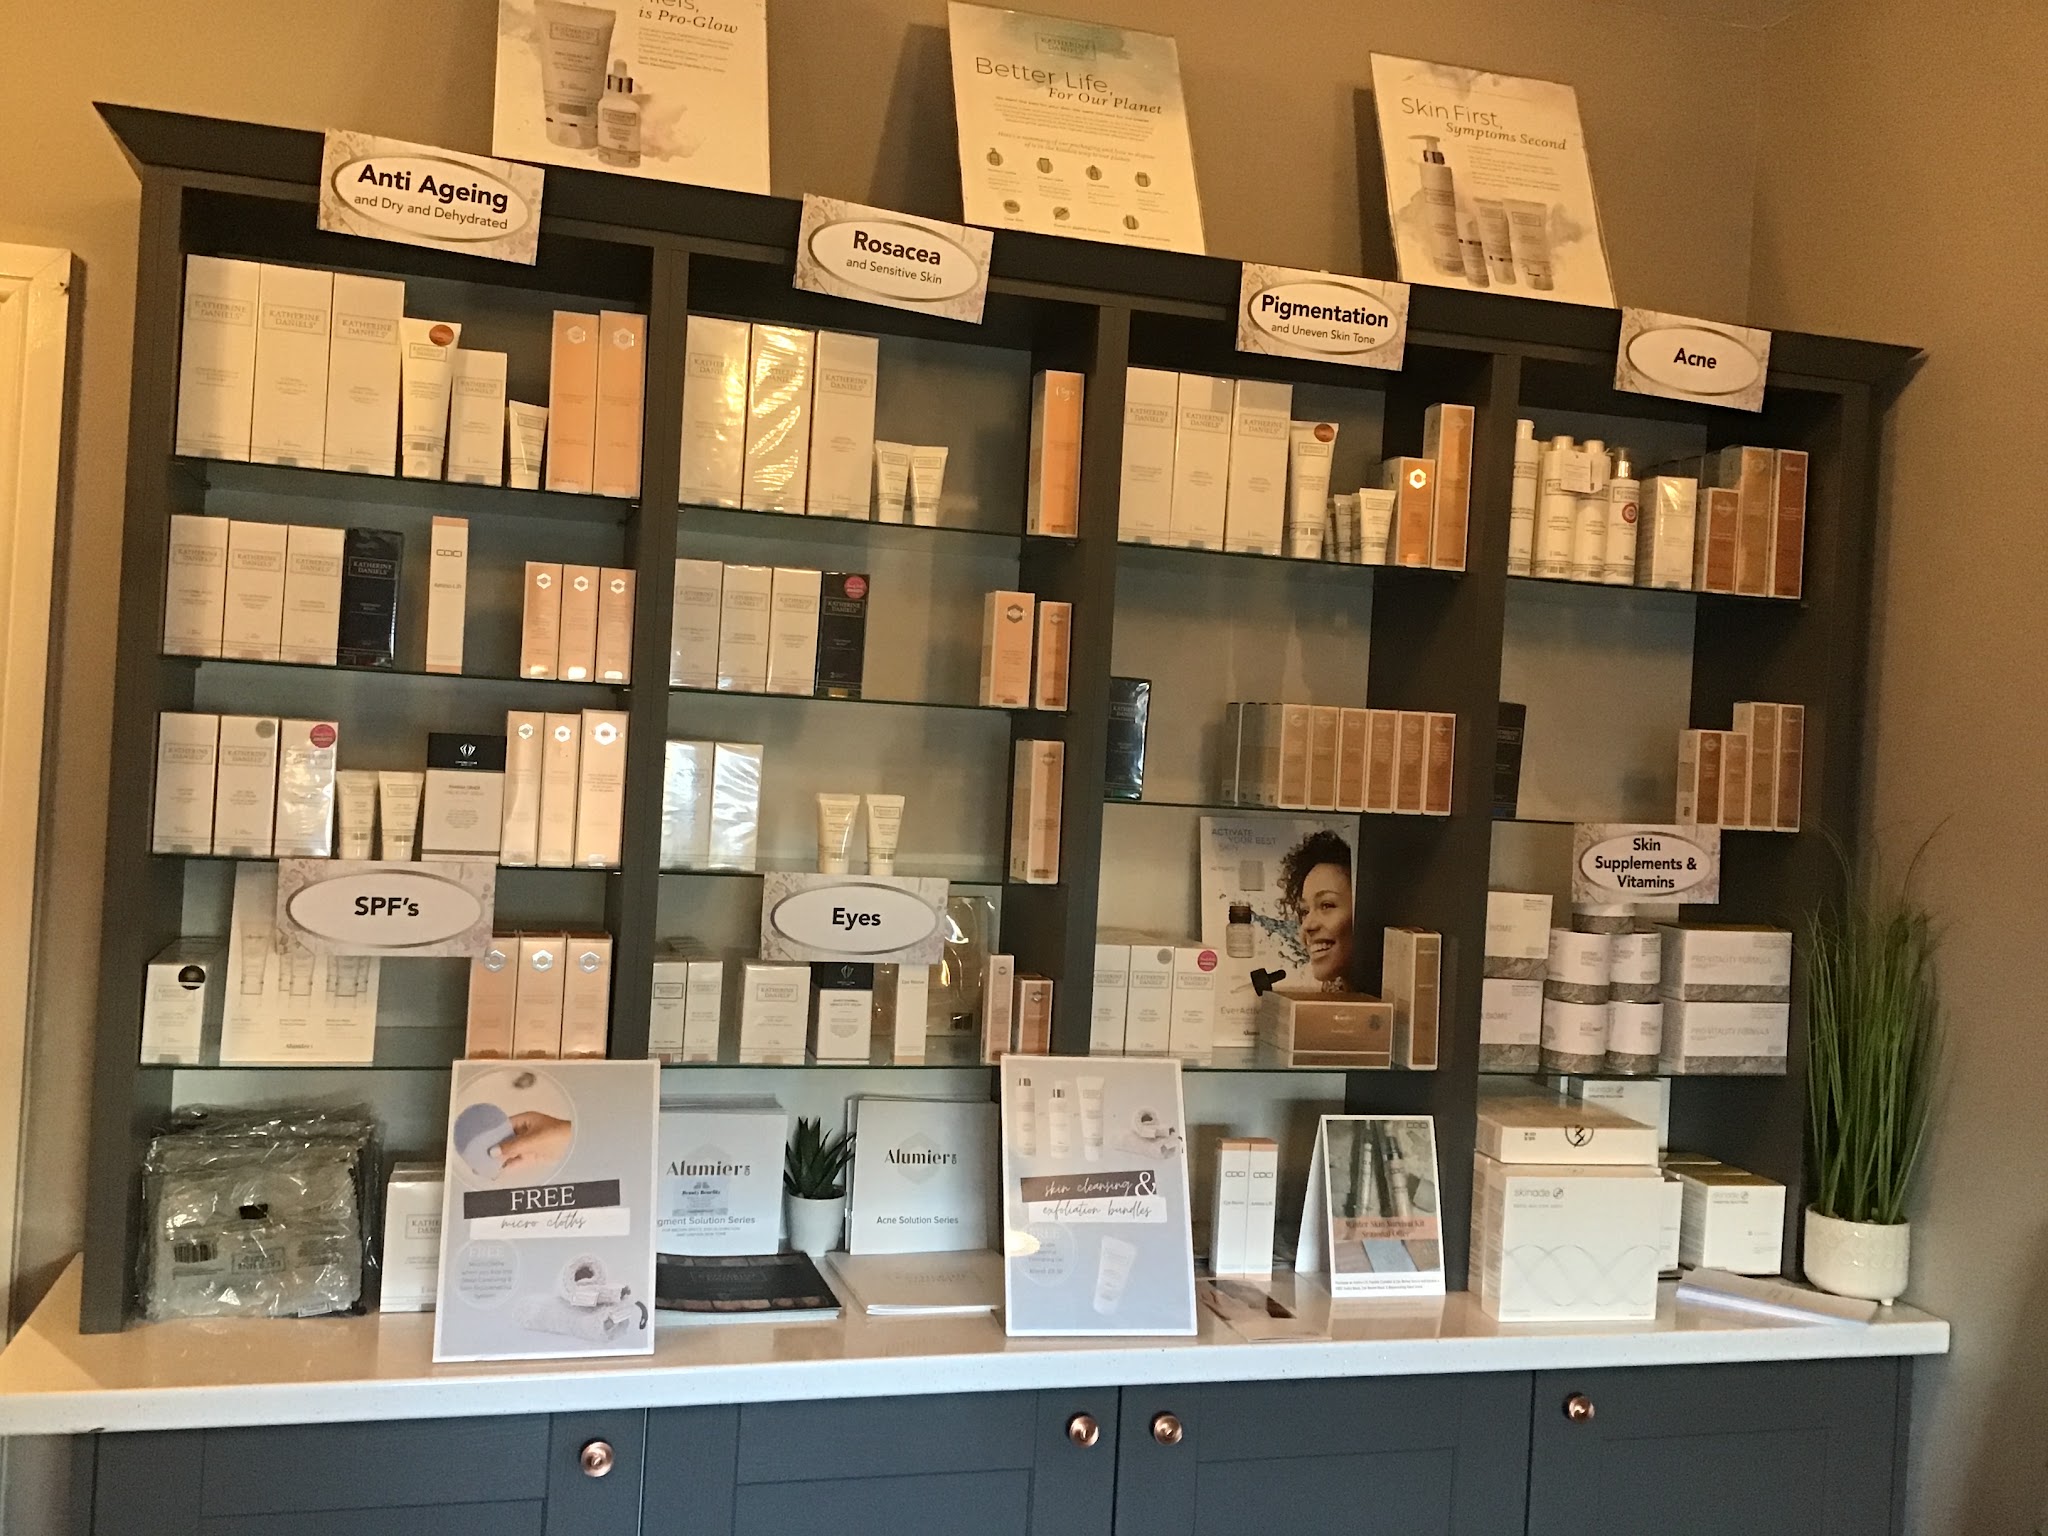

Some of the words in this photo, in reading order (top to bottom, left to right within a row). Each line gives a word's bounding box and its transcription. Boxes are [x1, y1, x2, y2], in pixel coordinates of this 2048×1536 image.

[639, 7, 652, 19] is
[658, 9, 738, 34] Pro-Glow
[975, 57, 1055, 85] Better
[1065, 71, 1114, 97] Life,
[1049, 87, 1074, 101] For
[1078, 92, 1109, 106] Our
[1113, 97, 1163, 115] Planet
[1401, 97, 1449, 120] Skin
[1454, 104, 1504, 130] First,
[1445, 122, 1517, 144] Symptoms
[1520, 133, 1567, 151] Second
[357, 163, 412, 191] Anti
[418, 175, 509, 214] Ageing
[354, 194, 378, 207] and
[381, 197, 404, 214] Dry
[407, 204, 431, 216] and
[434, 207, 508, 230] Dehydrated
[852, 230, 941, 266] Rosacea
[846, 258, 867, 270] and
[869, 261, 917, 280] Sensitive
[920, 271, 943, 285] Skin
[1261, 294, 1389, 328] Pigmentation
[1271, 323, 1290, 334] and
[1292, 325, 1328, 339] Uneven
[1330, 329, 1350, 341] Skin
[1353, 333, 1376, 345] Tone
[1673, 347, 1717, 369] Acne
[1632, 837, 1661, 852] Skin
[1594, 855, 1683, 873] Supplements
[1686, 857, 1697, 871] &
[1616, 874, 1675, 889] Vitamins
[354, 896, 420, 917] SPF's
[832, 907, 881, 931] Eyes
[666, 1160, 743, 1176] Alumier
[884, 1149, 951, 1165] Alumier
[1044, 1181, 1071, 1198] skin
[1077, 1177, 1133, 1196] cleansing
[1134, 1171, 1156, 1197] &
[1514, 1188, 1551, 1198] skinade
[510, 1185, 576, 1211] FREE
[501, 1218, 539, 1230] micro
[546, 1210, 587, 1229] cloths
[689, 1216, 726, 1225] Solution
[728, 1216, 756, 1224] Series
[876, 1216, 897, 1225] Acne
[899, 1216, 932, 1225] Solution
[933, 1215, 959, 1224] Series
[1042, 1199, 1101, 1221] exfoliation
[1108, 1201, 1152, 1218] bundles
